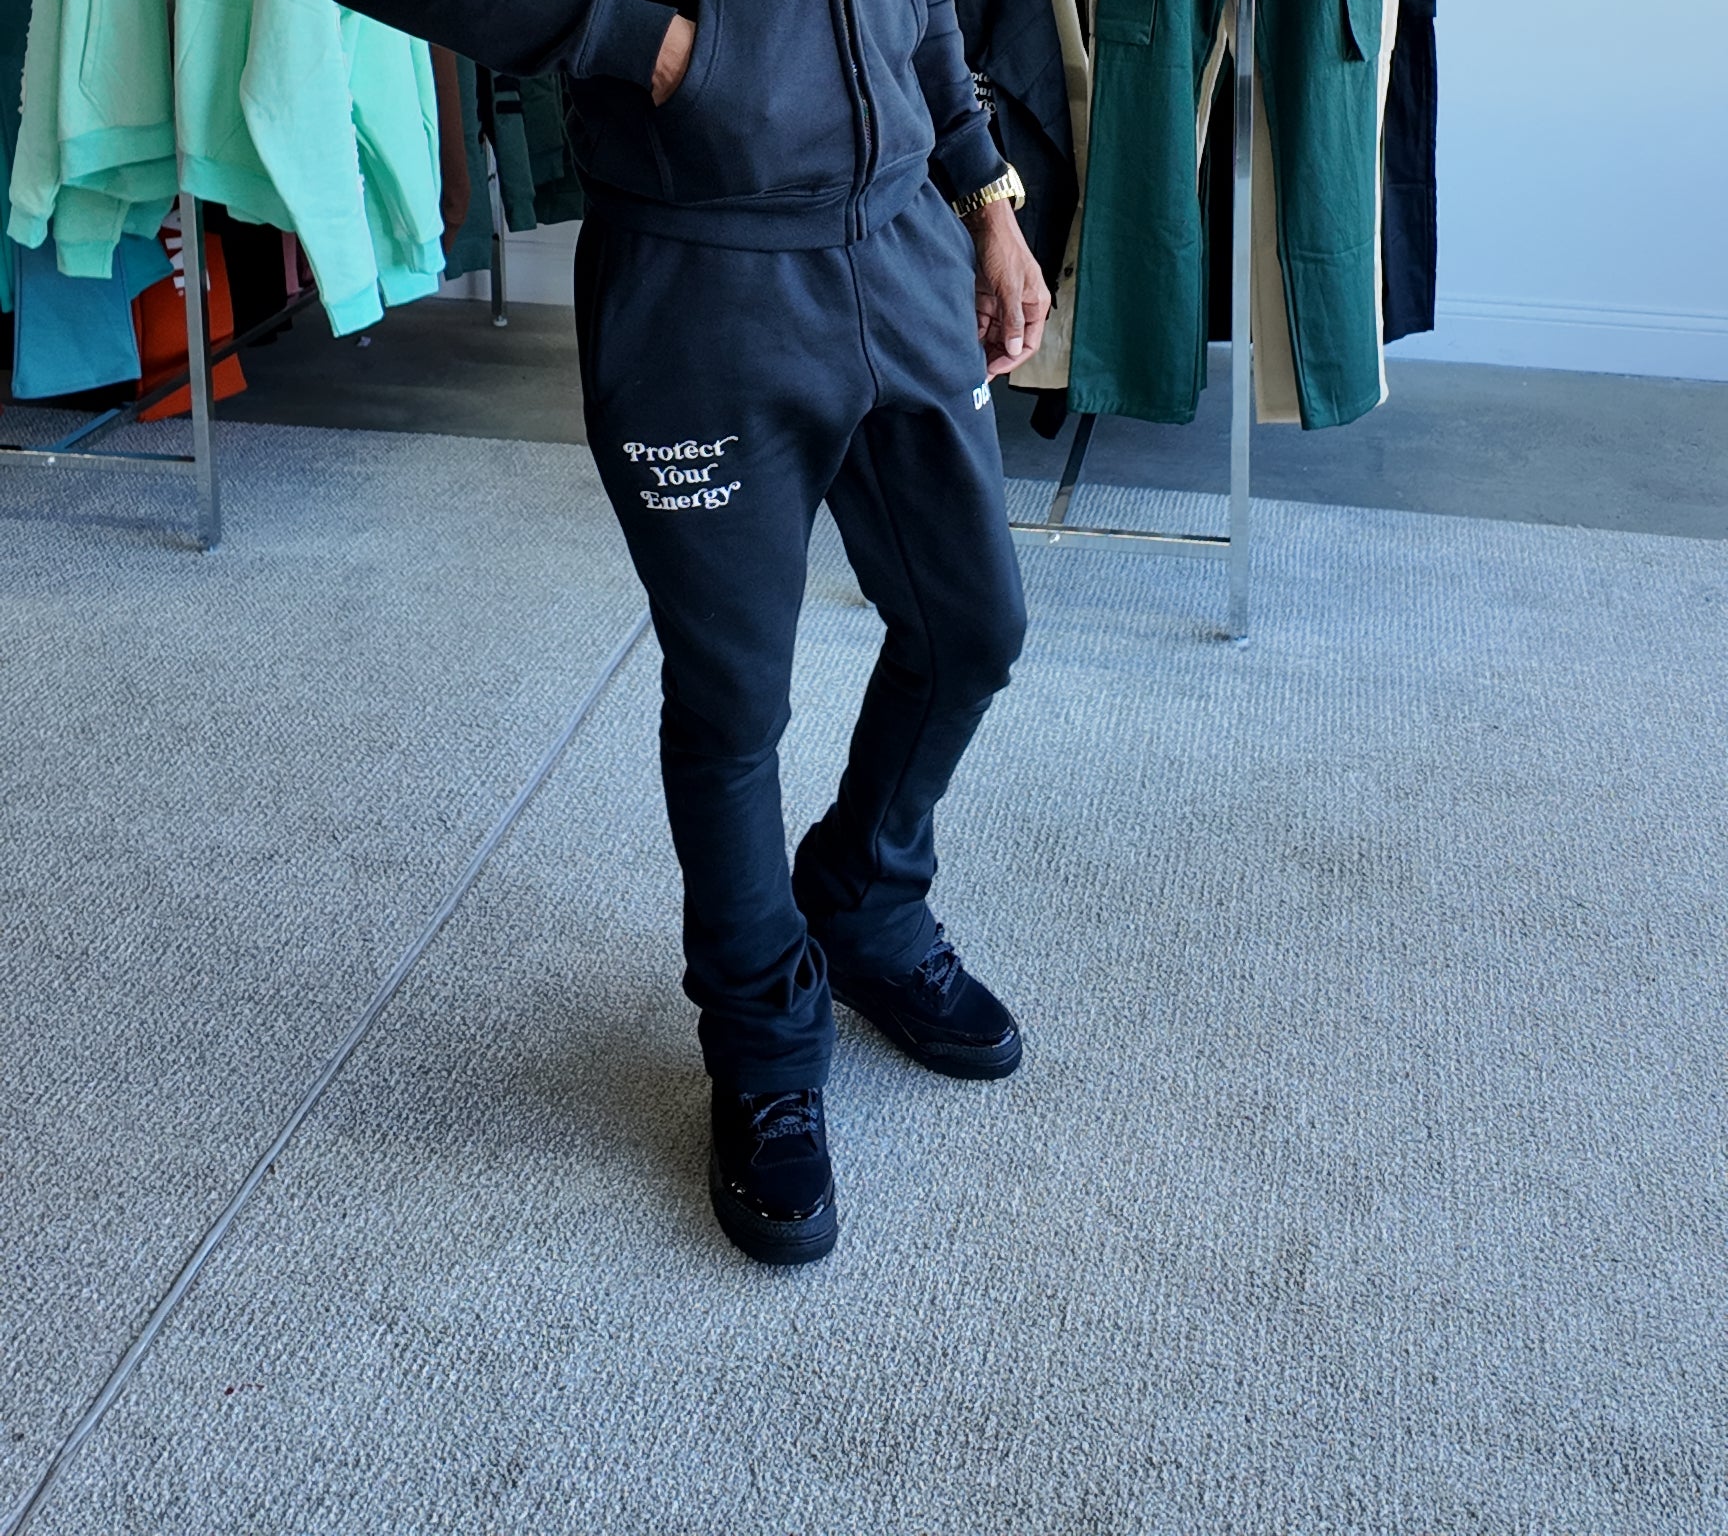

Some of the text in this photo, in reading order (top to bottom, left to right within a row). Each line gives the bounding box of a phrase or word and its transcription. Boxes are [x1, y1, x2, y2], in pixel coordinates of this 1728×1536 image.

[622, 435, 739, 462] Protect
[650, 462, 719, 487] Your
[639, 480, 742, 511] Energy
